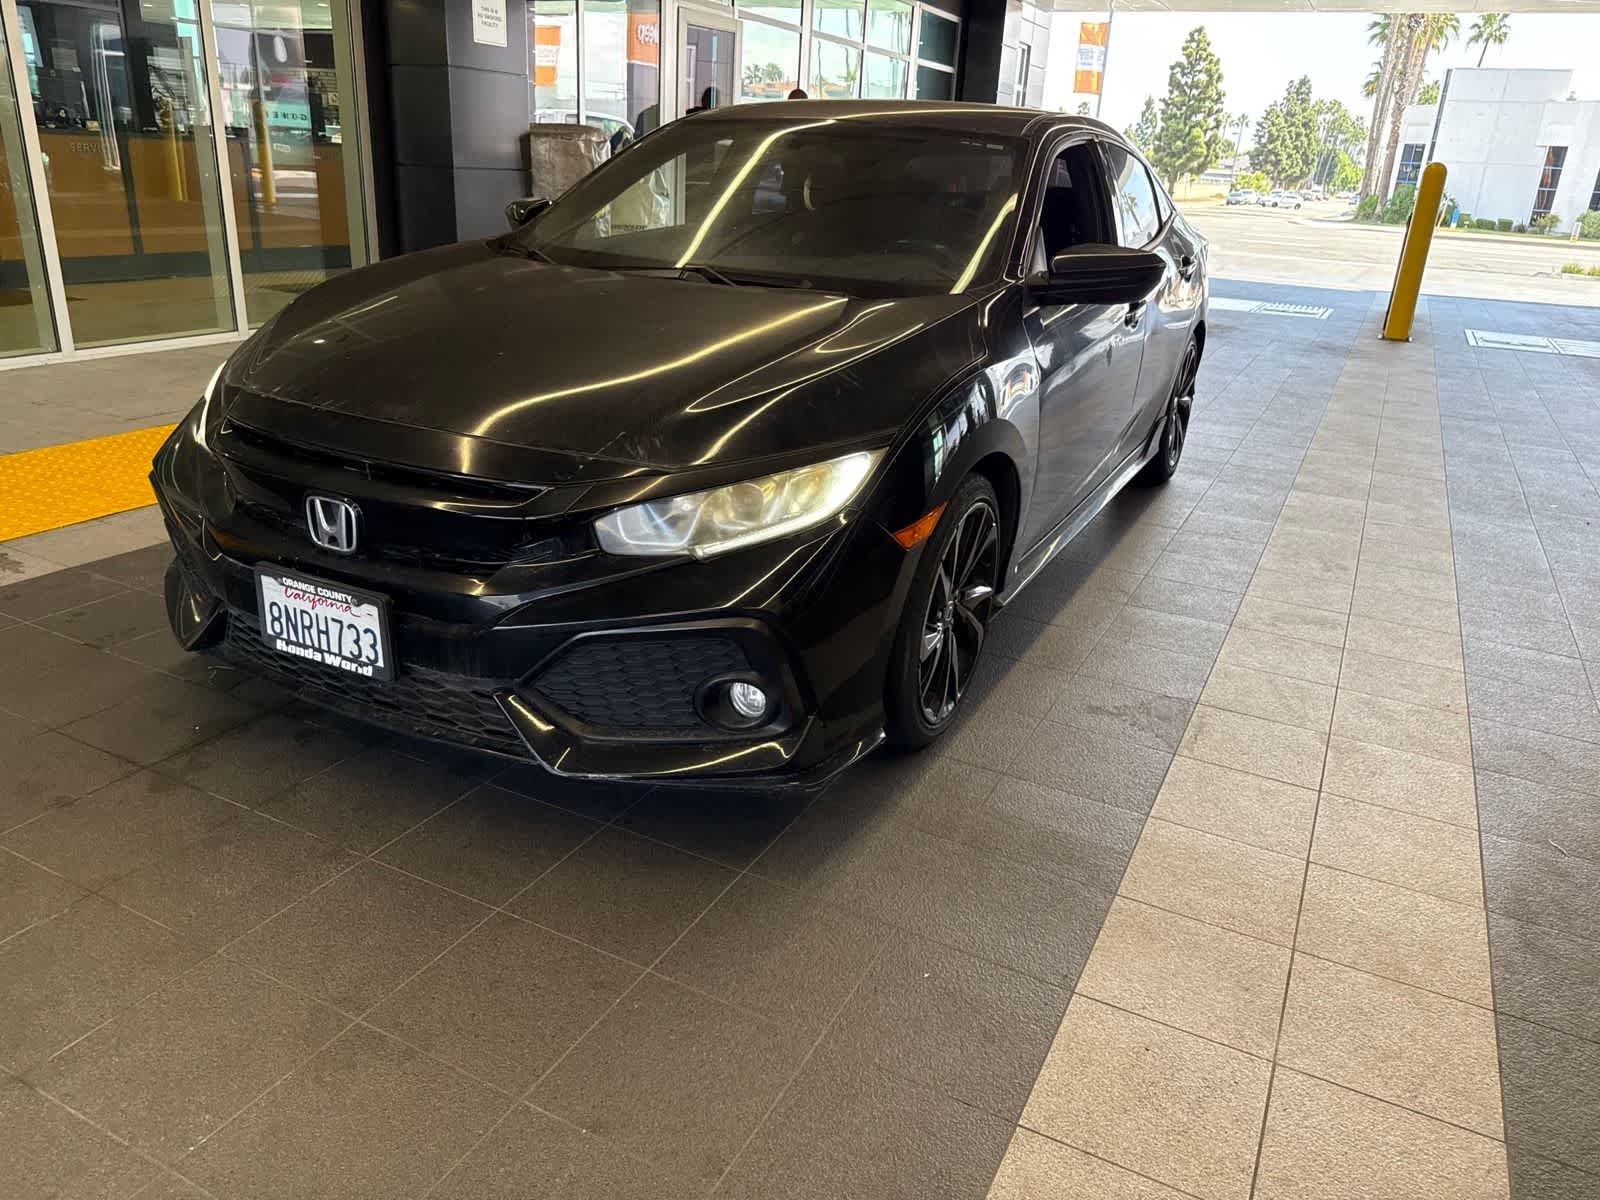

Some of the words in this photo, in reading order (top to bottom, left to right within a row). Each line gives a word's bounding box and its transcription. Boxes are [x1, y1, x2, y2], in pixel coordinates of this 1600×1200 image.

[282, 577, 316, 594] ORANGE
[317, 587, 352, 603] COUNTY
[269, 601, 380, 665] 8NRH733
[276, 639, 322, 662] Honda
[324, 652, 373, 677] World
